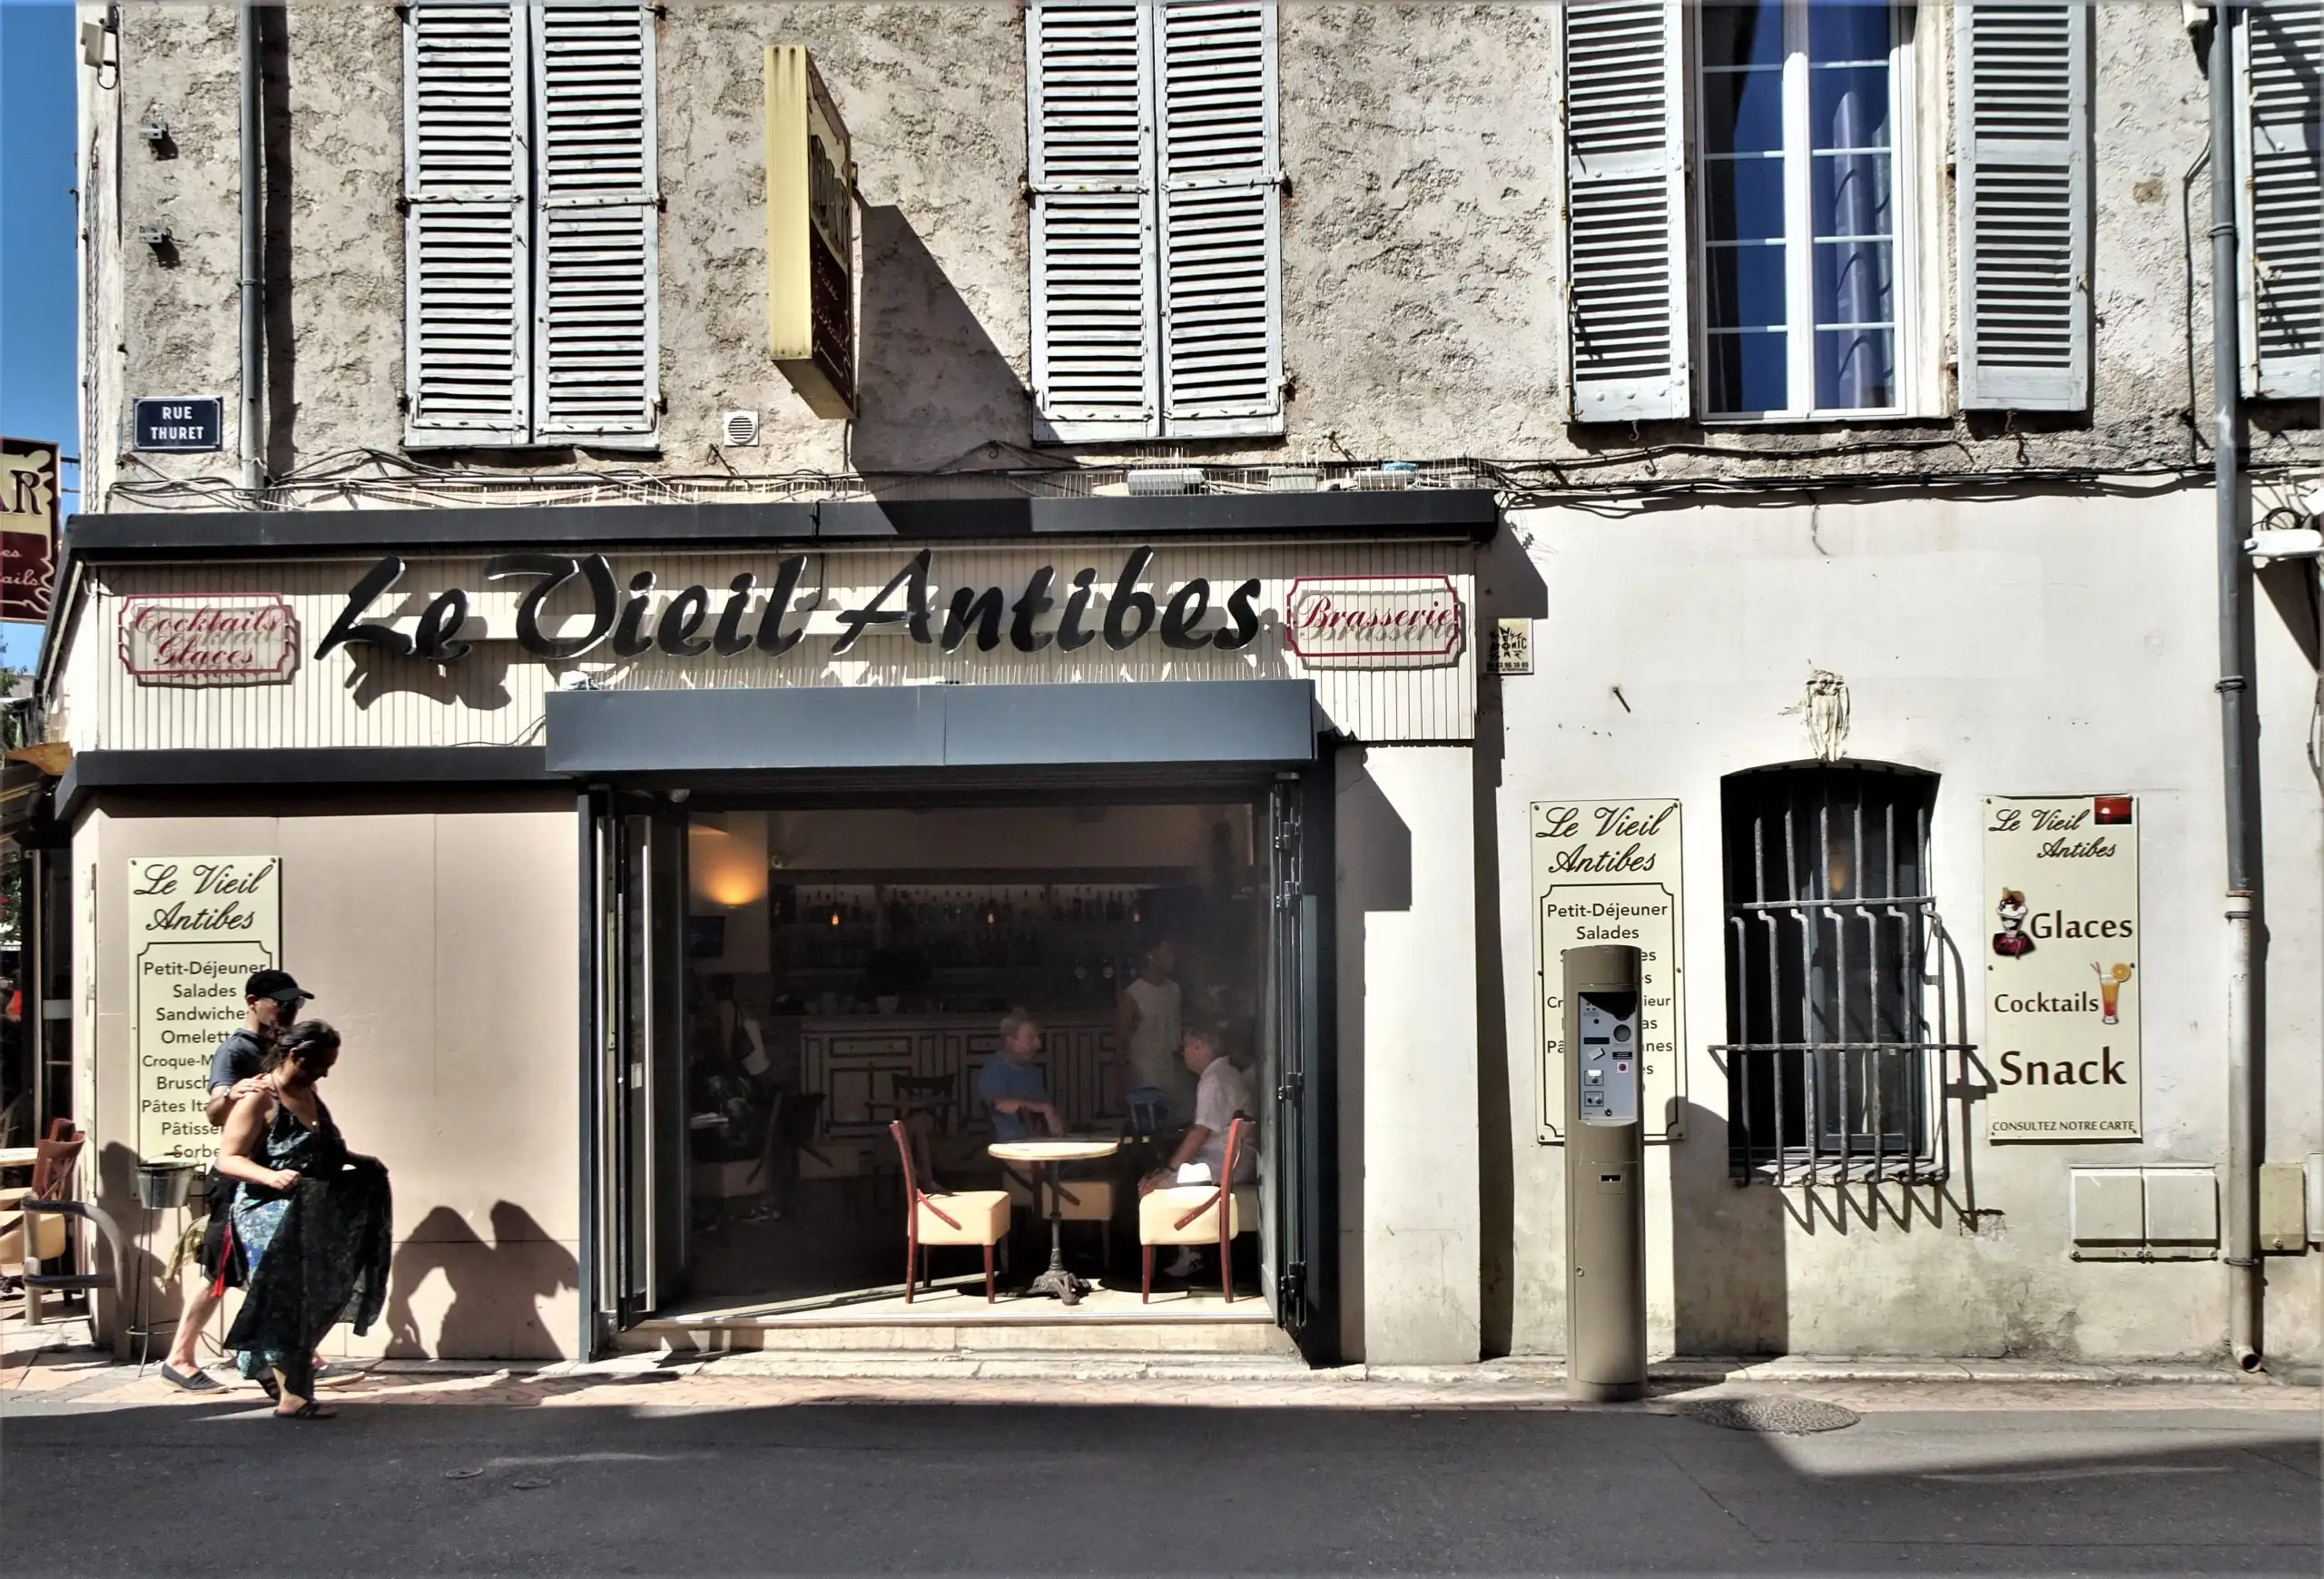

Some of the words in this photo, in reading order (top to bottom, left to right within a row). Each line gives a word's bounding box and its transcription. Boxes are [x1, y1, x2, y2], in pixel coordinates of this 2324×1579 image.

[162, 406, 192, 420] RUE
[150, 426, 204, 440] THURET
[0, 469, 44, 516] R
[313, 553, 472, 661] Le
[483, 552, 808, 660] Vieil
[830, 545, 1263, 656] Antibes
[1292, 592, 1453, 629] Brasserie
[133, 604, 280, 634] Cocktails
[153, 636, 255, 666] Glaces
[1535, 806, 1579, 837] Le
[1594, 806, 1674, 836] Vieil
[1988, 809, 2021, 831] Le
[2031, 809, 2090, 831] Vieil
[2036, 836, 2116, 858] Antibes
[1548, 843, 1656, 873] Antibes
[133, 864, 177, 894] Le
[192, 864, 273, 894] Vieil
[145, 901, 255, 930] Antibes
[1547, 903, 1668, 920] Petit-Déjeuner
[1576, 925, 1640, 940] Salades
[2030, 910, 2132, 939] Glaces
[143, 961, 266, 978] Petit-Déjeuner
[173, 983, 237, 998] Salades
[1994, 992, 2099, 1012] Cocktails
[156, 1006, 249, 1021] Sandwiche
[161, 1029, 231, 1043] Omelett
[143, 1054, 213, 1069] Croque-M
[2000, 1046, 2127, 1086] Snack
[157, 1075, 209, 1090] Brusch
[143, 1100, 186, 1112] Pâtes
[162, 1122, 223, 1135] Pâtisse
[1993, 1121, 2056, 1131] CONSULTEZ
[2059, 1121, 2097, 1130] NOTRE
[2100, 1120, 2134, 1130] CARTE
[173, 1144, 220, 1158] Sorbe
